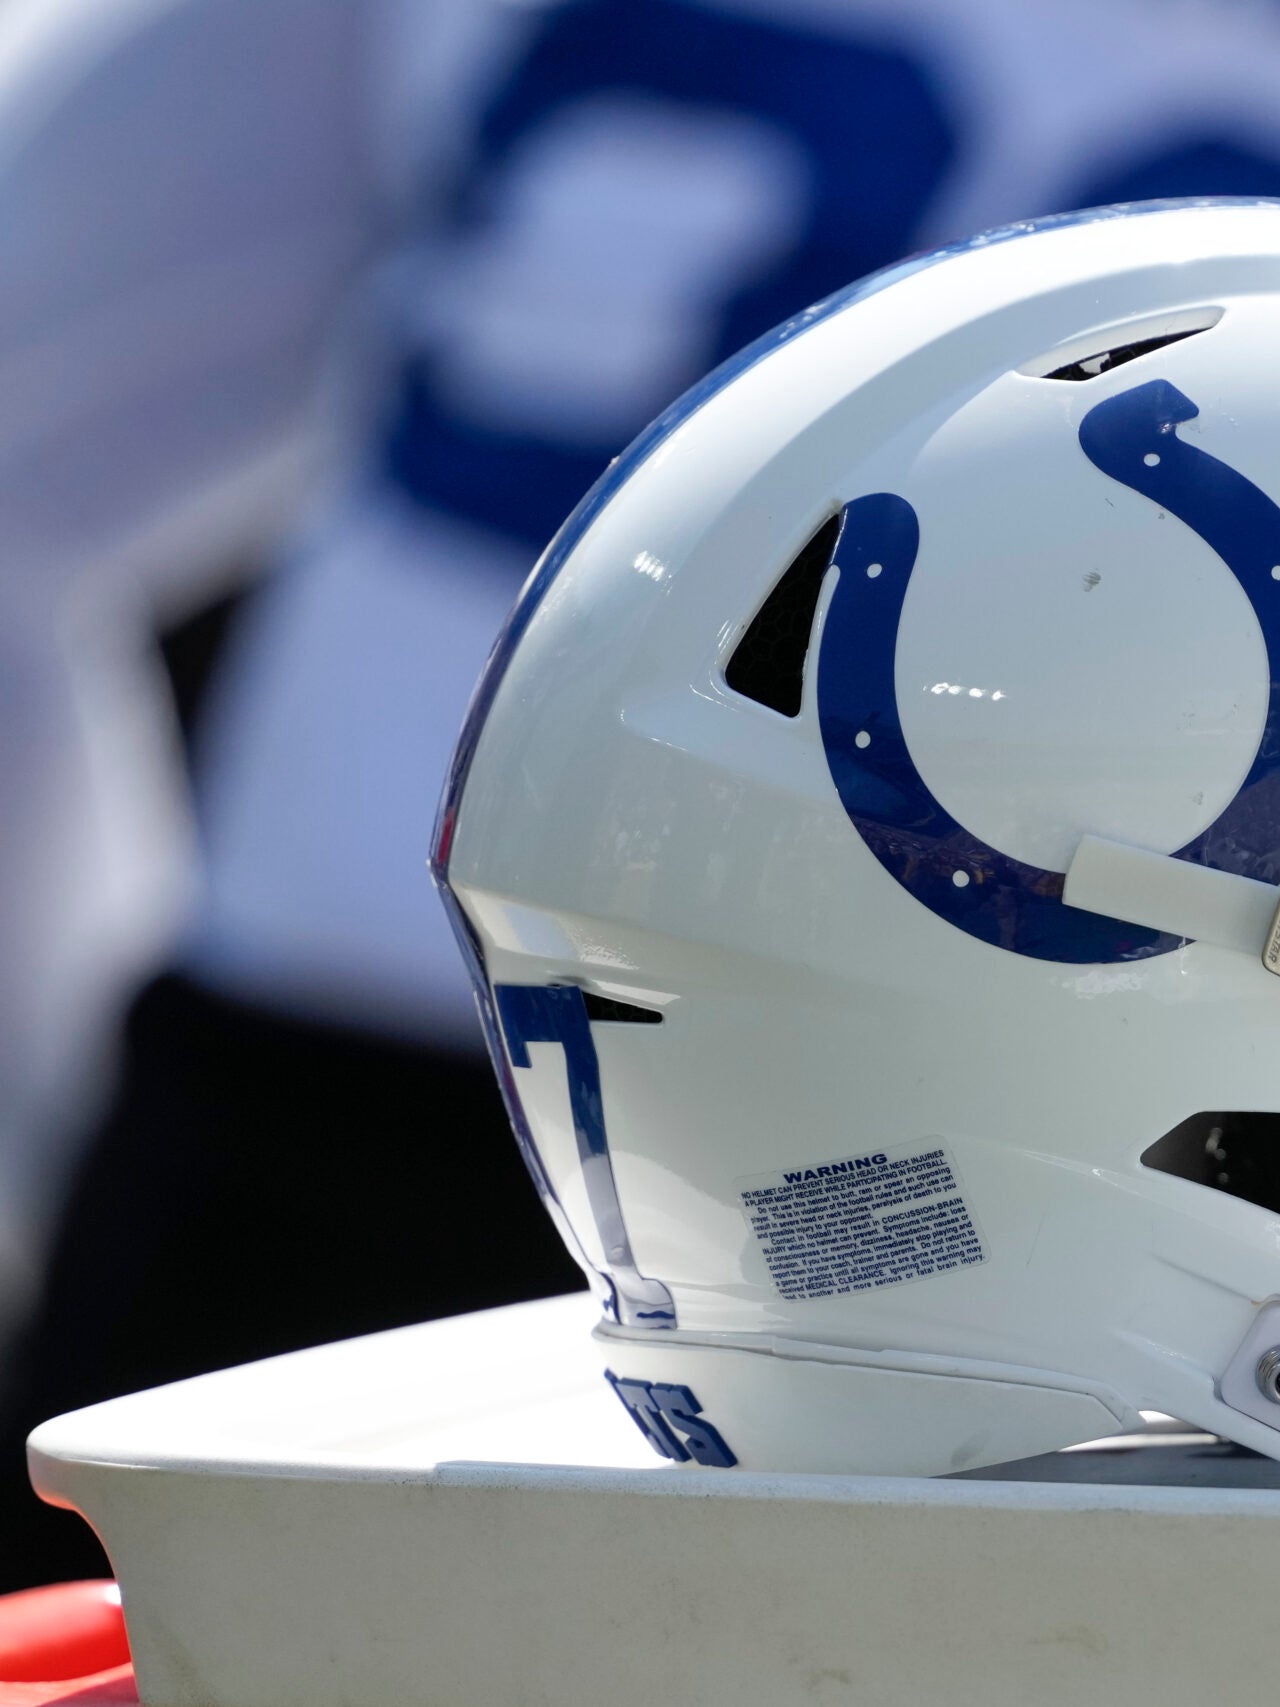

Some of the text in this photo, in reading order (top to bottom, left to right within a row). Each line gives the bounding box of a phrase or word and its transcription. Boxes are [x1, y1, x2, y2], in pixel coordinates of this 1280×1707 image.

[494, 984, 678, 1328] 7
[752, 1188, 776, 1197] HELMET
[793, 1180, 823, 1190] PREVENT
[825, 1173, 855, 1185] SERIOUS
[856, 1168, 876, 1178] HEAD
[889, 1160, 910, 1169] NECK
[911, 1150, 944, 1164] INJURIES
[783, 1154, 887, 1183] WARNING
[749, 1197, 774, 1206] PLAYER
[774, 1194, 793, 1202] MIGHT
[795, 1188, 823, 1199] RECEIVE
[824, 1184, 846, 1193] WHILE
[847, 1171, 898, 1188] PARTICIPATING
[800, 1216, 816, 1224] head
[872, 1197, 903, 1210] paralysis
[913, 1189, 933, 1199] death
[943, 1183, 956, 1192] you
[801, 1206, 828, 1215] violation
[848, 1194, 874, 1205] football
[894, 1187, 907, 1195] and
[908, 1182, 925, 1191] such
[807, 1196, 830, 1205] helmet
[884, 1180, 903, 1189] spear
[917, 1167, 951, 1180] opposing
[763, 1246, 785, 1254] INJURY
[788, 1243, 806, 1251] which
[816, 1237, 838, 1246] helmet
[883, 1219, 920, 1232] Symptoms
[769, 1228, 795, 1238] possible
[796, 1226, 814, 1234] injury
[823, 1221, 837, 1229] your
[771, 1236, 796, 1245] Contact
[806, 1230, 831, 1240] football
[851, 1222, 871, 1231] result
[882, 1198, 965, 1224] CONCUSSION-BRAIN
[873, 1238, 914, 1251] immediately
[916, 1234, 931, 1242] stop
[932, 1226, 958, 1238] playing
[959, 1221, 972, 1230] and
[773, 1271, 790, 1279] report
[815, 1265, 829, 1273] your
[853, 1256, 874, 1264] trainer
[876, 1252, 889, 1260] and
[932, 1238, 944, 1246] not
[945, 1233, 967, 1242] return
[774, 1250, 820, 1262] consciousness
[781, 1279, 797, 1287] game
[807, 1273, 833, 1283] practice
[835, 1268, 849, 1277] until
[861, 1260, 896, 1272] symptoms
[911, 1252, 929, 1262] gone
[931, 1246, 944, 1255] and
[946, 1244, 959, 1252] you
[961, 1238, 978, 1246] have
[805, 1280, 837, 1290] MEDICAL
[889, 1263, 920, 1275] Ignoring
[936, 1250, 965, 1262] warning
[967, 1246, 981, 1254] may
[809, 1290, 833, 1298] another
[875, 1276, 902, 1286] serious
[917, 1266, 934, 1275] fatal
[937, 1261, 957, 1270] brain
[604, 1368, 738, 1468] TS
